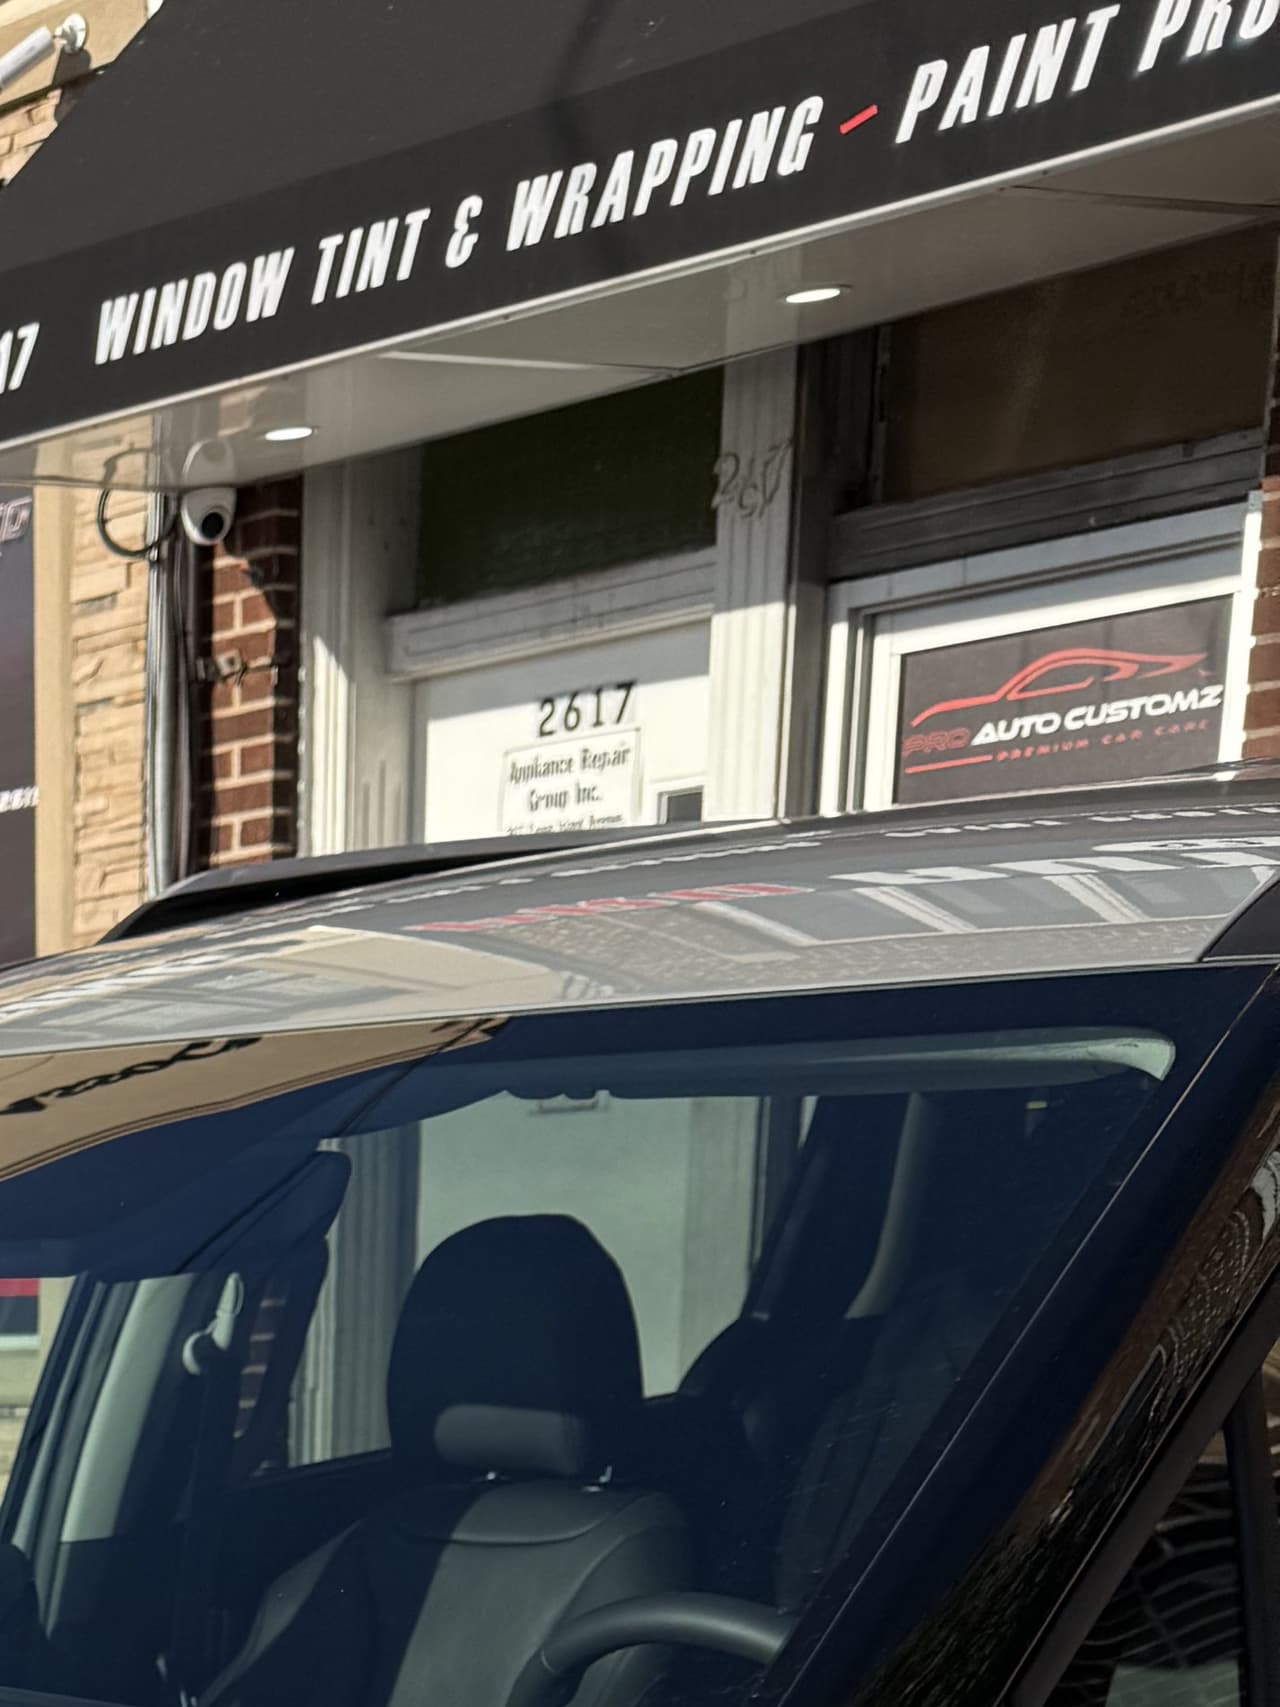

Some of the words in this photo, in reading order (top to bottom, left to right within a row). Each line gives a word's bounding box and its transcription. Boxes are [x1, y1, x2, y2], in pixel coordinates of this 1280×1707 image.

[96, 247, 295, 366] WINDOW
[311, 207, 430, 305] TINT
[445, 195, 484, 269] &
[506, 96, 823, 252] WRAPPING
[895, 4, 1120, 144] PAINT
[538, 680, 637, 738] 2617
[971, 712, 1061, 746] AUTO
[1063, 684, 1225, 729] CUSTOMZ
[580, 741, 631, 772] Repair
